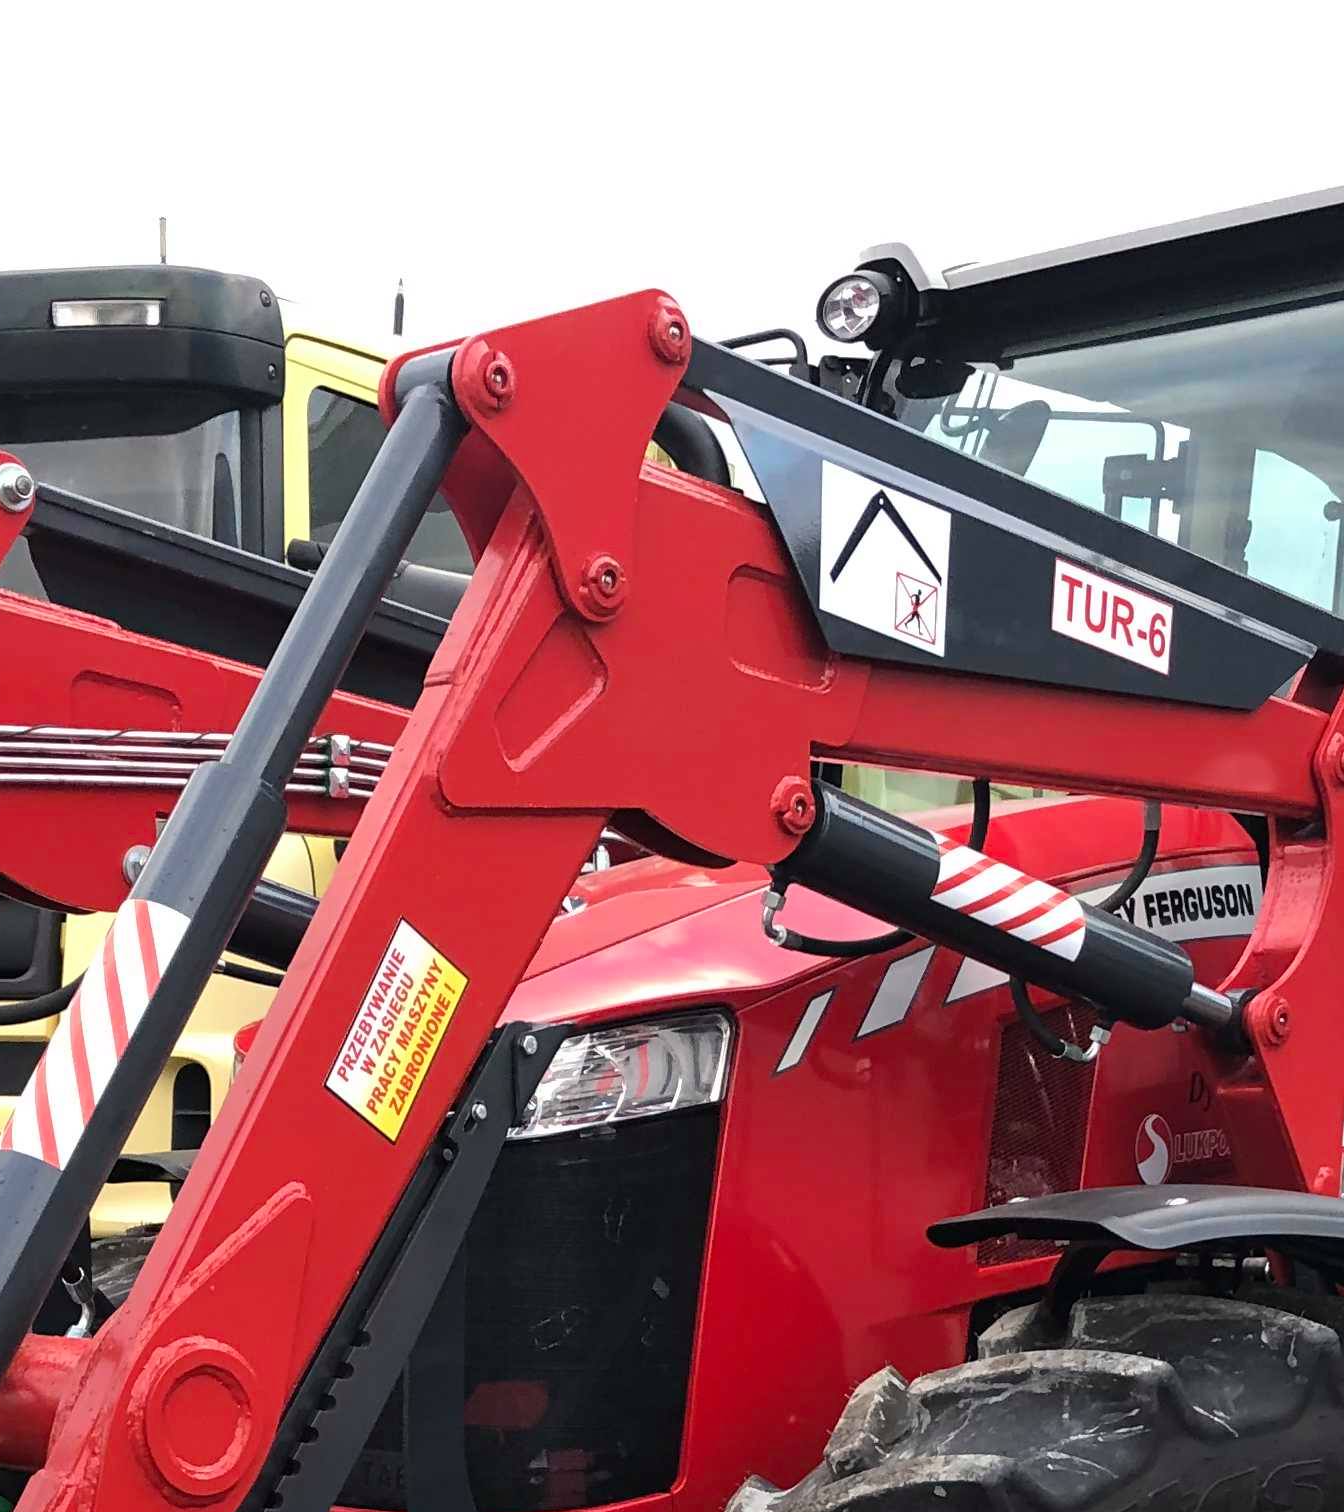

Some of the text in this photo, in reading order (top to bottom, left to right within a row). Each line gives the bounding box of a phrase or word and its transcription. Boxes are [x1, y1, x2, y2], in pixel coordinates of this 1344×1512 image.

[1061, 573, 1167, 658] TUR-6
[1143, 883, 1255, 928] FERGUSON
[336, 948, 406, 1082] PRZEBYWANIE
[359, 1054, 377, 1076] W
[366, 958, 443, 1115] PRACY MASZYNY
[388, 993, 451, 1116] ZABRONIONE
